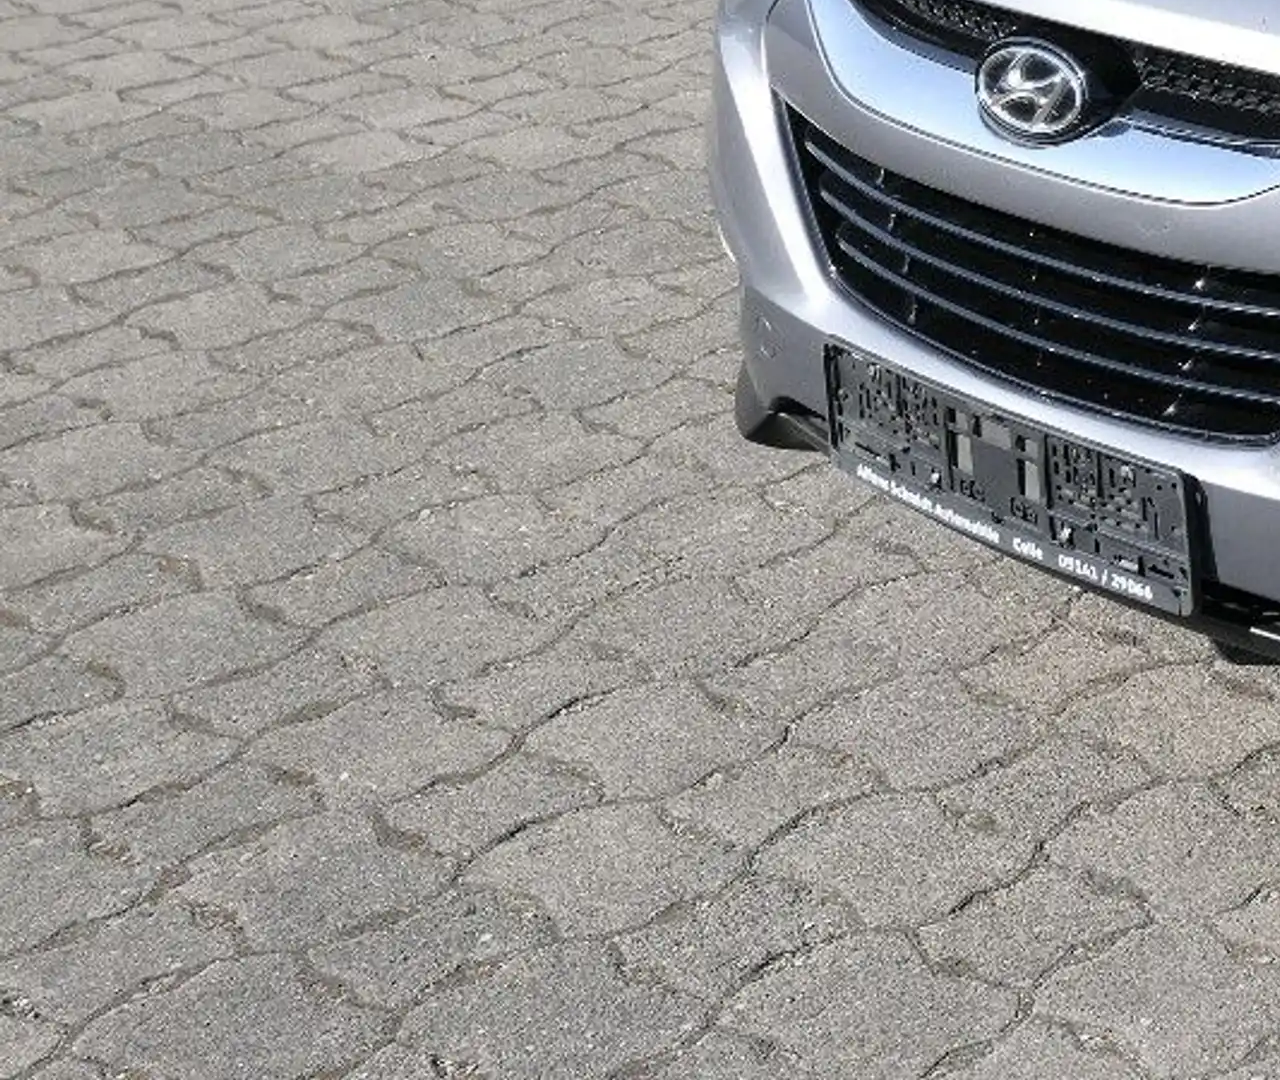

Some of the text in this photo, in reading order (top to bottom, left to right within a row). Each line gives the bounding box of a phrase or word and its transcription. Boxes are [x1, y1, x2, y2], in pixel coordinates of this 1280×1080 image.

[933, 504, 1000, 544] Automobile
[1012, 537, 1043, 560] Celle
[1058, 554, 1098, 580] 05141
